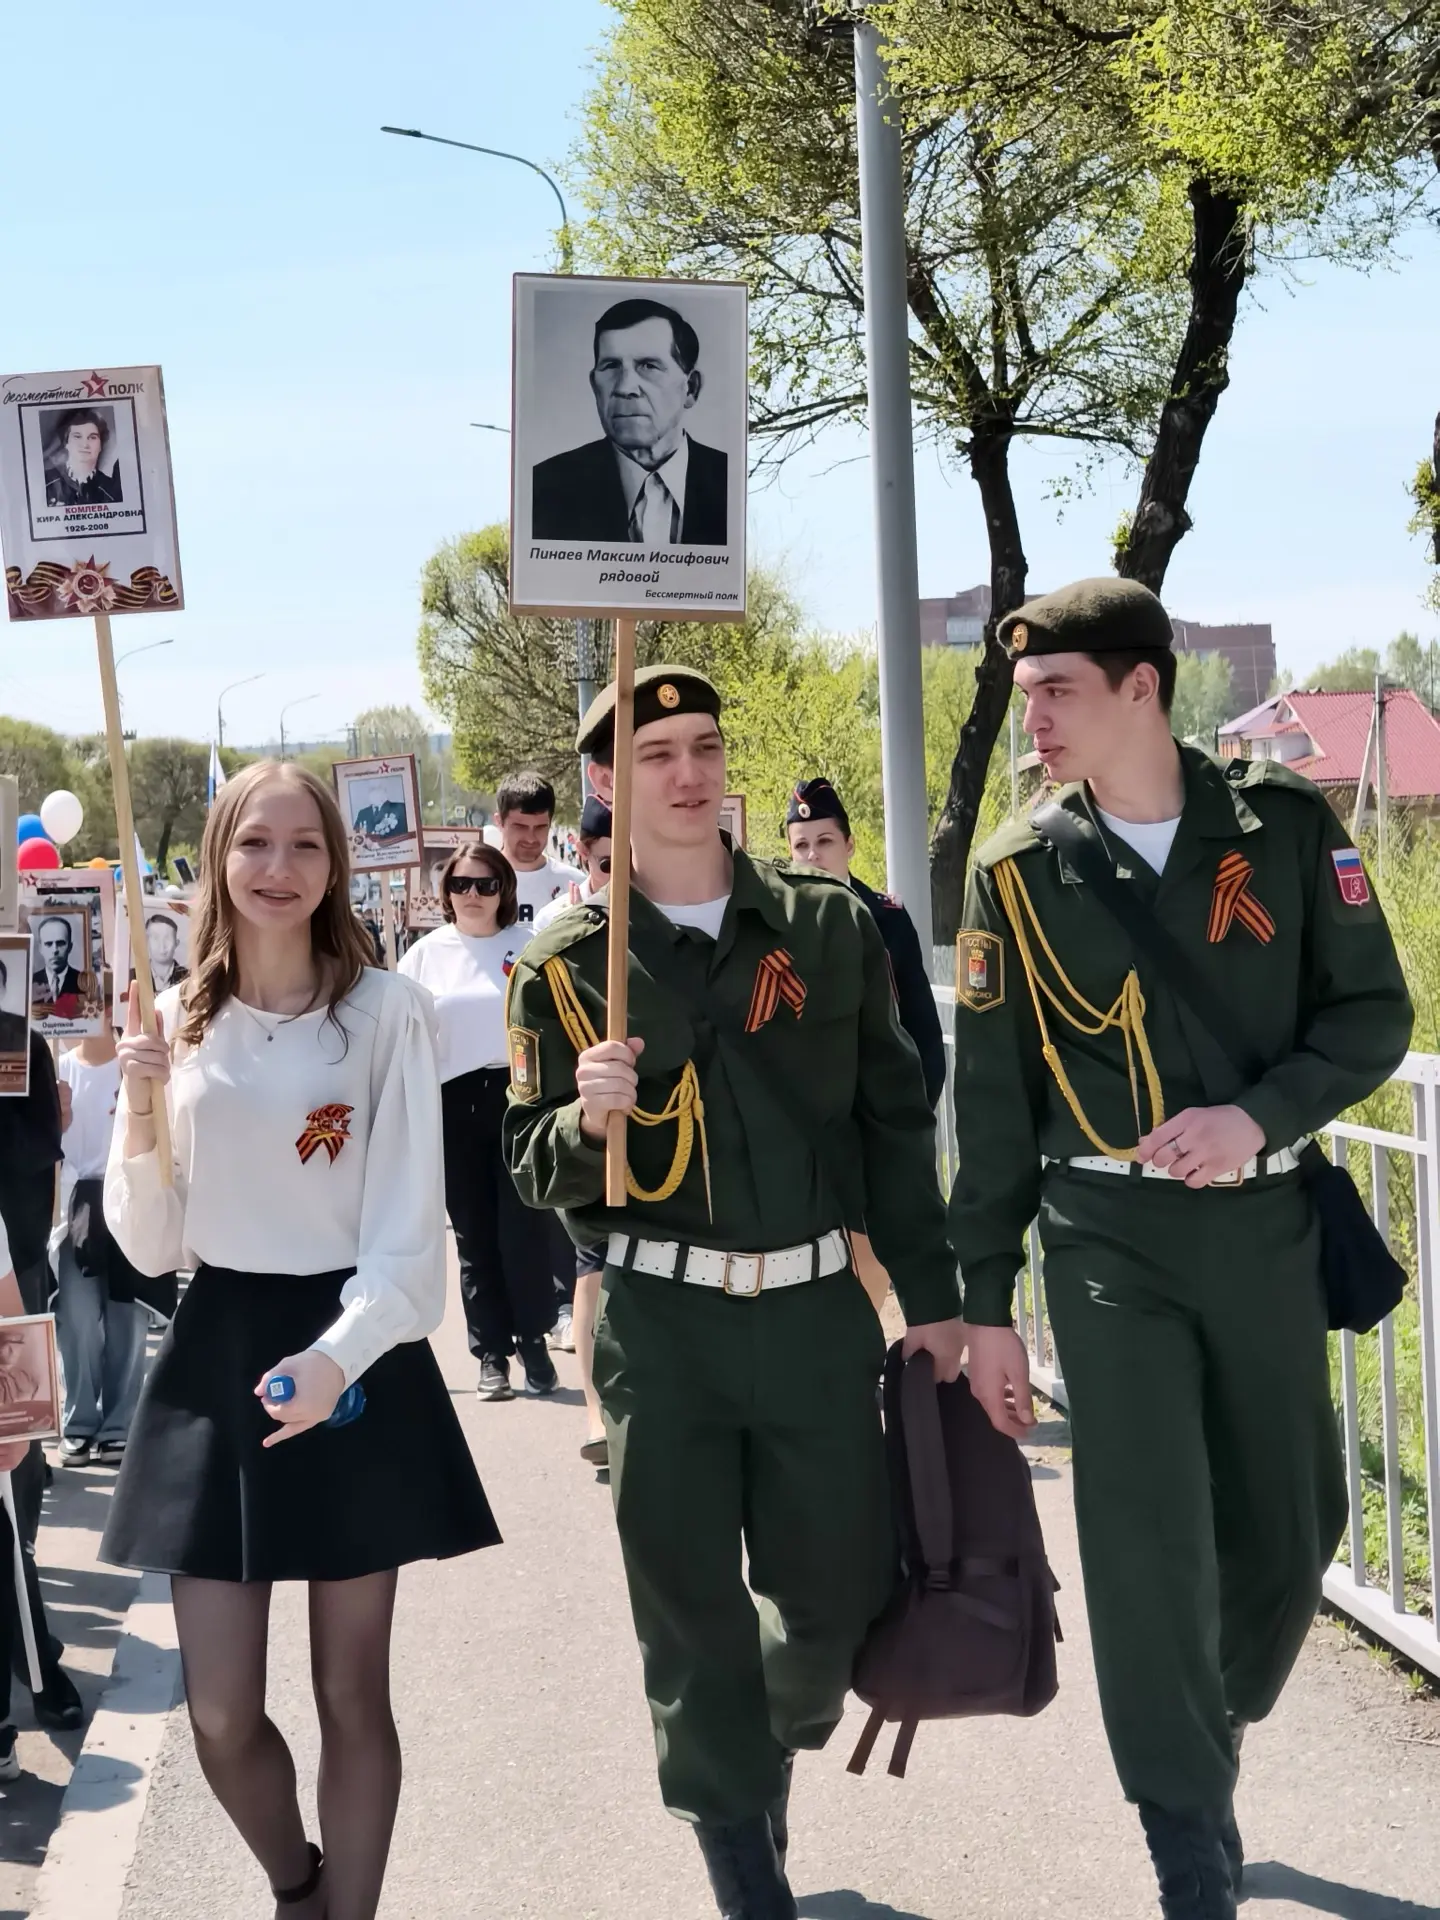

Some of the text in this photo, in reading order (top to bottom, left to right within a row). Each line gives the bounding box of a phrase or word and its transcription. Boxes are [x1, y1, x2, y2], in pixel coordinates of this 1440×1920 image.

[63, 509, 143, 521] АЛЕКСАНДРОВНА
[65, 505, 109, 514] КОМЛЕВА
[65, 523, 109, 533] 1926-2008
[529, 547, 730, 566] Пинаев Максим Иосифович
[599, 570, 660, 584] рядовой
[645, 589, 739, 601] Бессмертный полк
